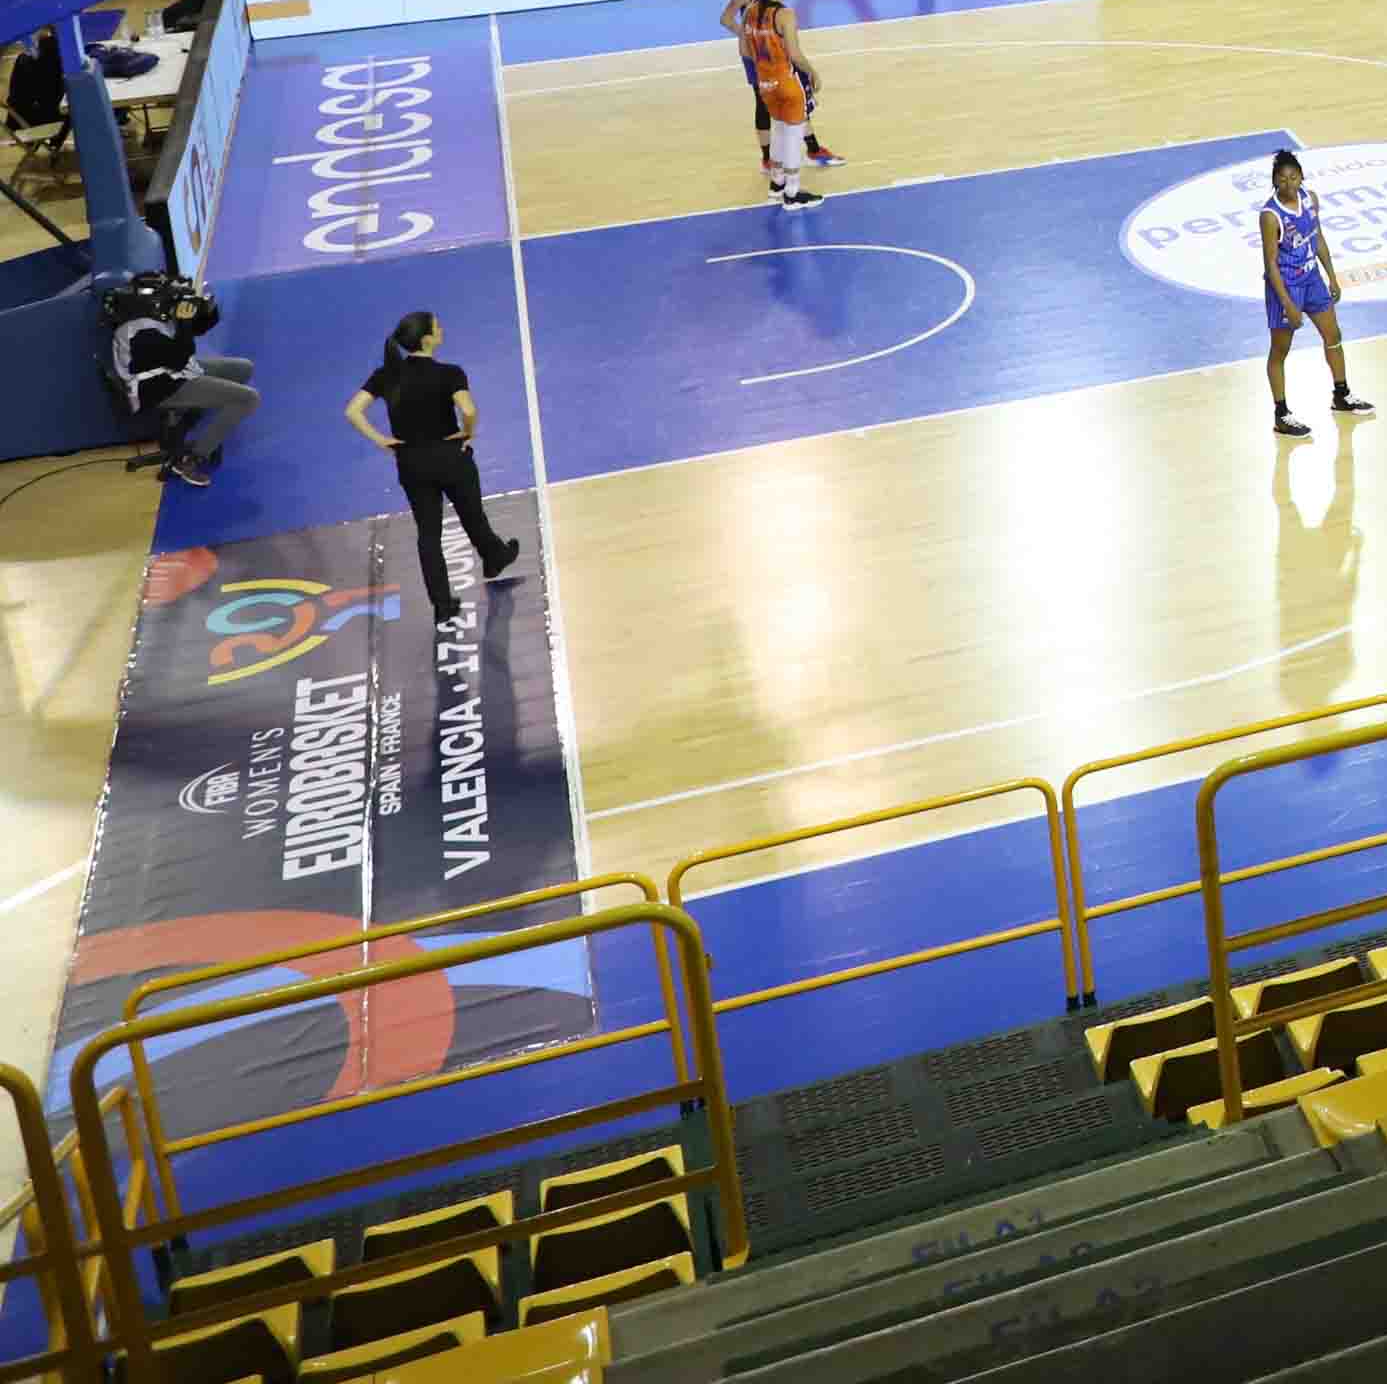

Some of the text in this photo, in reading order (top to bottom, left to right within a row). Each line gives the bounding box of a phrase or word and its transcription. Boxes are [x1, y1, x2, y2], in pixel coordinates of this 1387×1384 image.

[272, 54, 434, 255] endesa
[204, 769, 241, 809] FIBA
[241, 726, 285, 840] WOMEN'S
[282, 671, 369, 881] EUROBASKET
[378, 691, 402, 816] SPAIN FRANCE
[438, 696, 491, 881] VALENCIA
